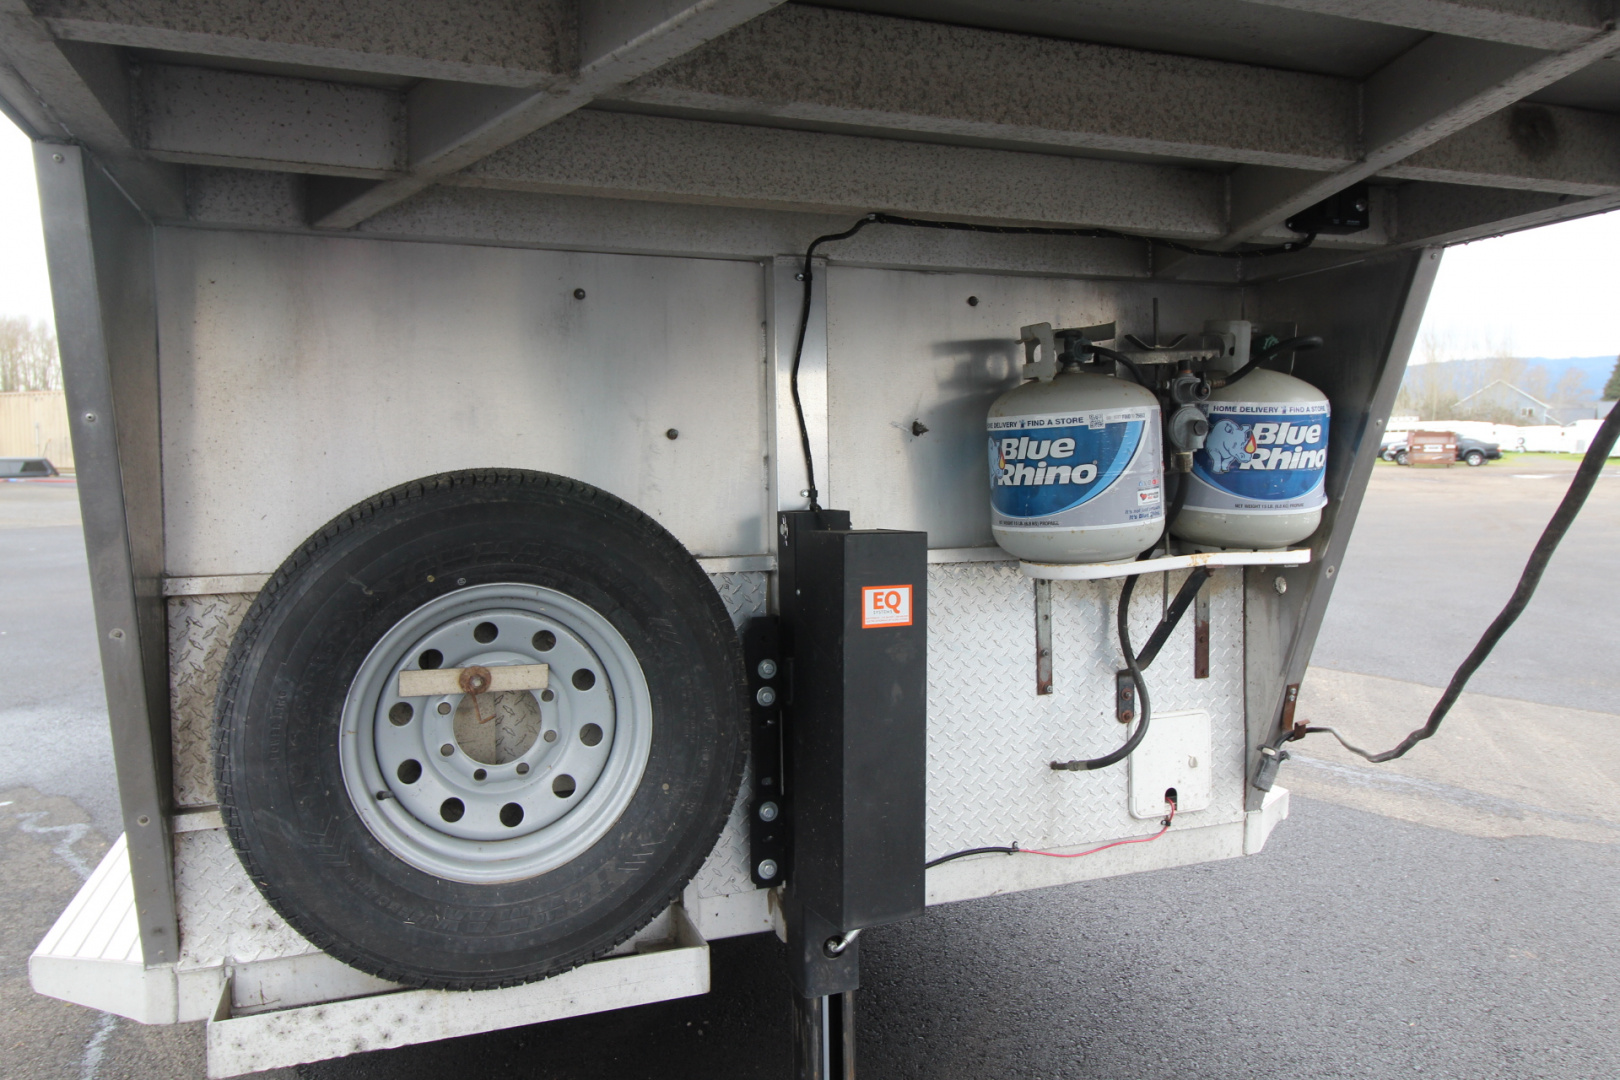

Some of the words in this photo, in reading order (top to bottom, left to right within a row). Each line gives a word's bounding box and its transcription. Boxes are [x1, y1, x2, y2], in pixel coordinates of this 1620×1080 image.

[1213, 405, 1237, 413] HOME
[994, 421, 1018, 429] DELIVERY
[1027, 420, 1045, 428] FIND
[1055, 416, 1084, 426] STORE
[1253, 422, 1322, 445] Blue
[1001, 436, 1076, 460] Blue
[1239, 446, 1326, 470] Rhino
[998, 461, 1098, 486] Rhino
[872, 590, 902, 614] EQ
